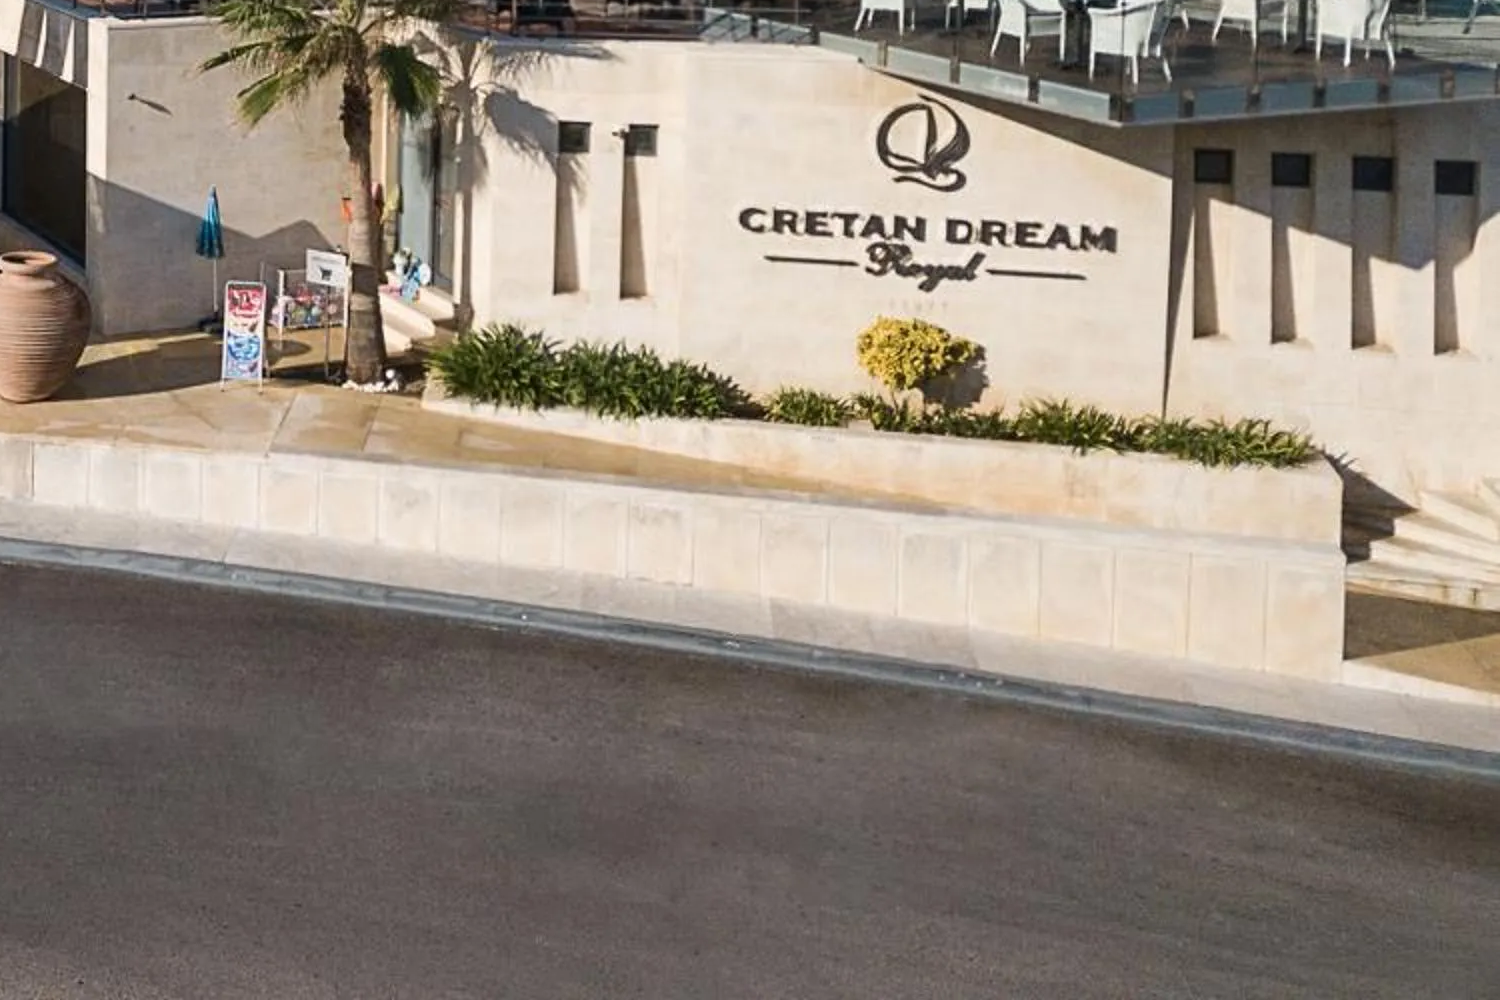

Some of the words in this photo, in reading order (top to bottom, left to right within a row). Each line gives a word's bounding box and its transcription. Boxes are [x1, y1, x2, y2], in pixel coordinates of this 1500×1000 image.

[738, 206, 927, 242] CRETAN
[945, 216, 1119, 253] DREAM
[865, 241, 986, 293] Royal
